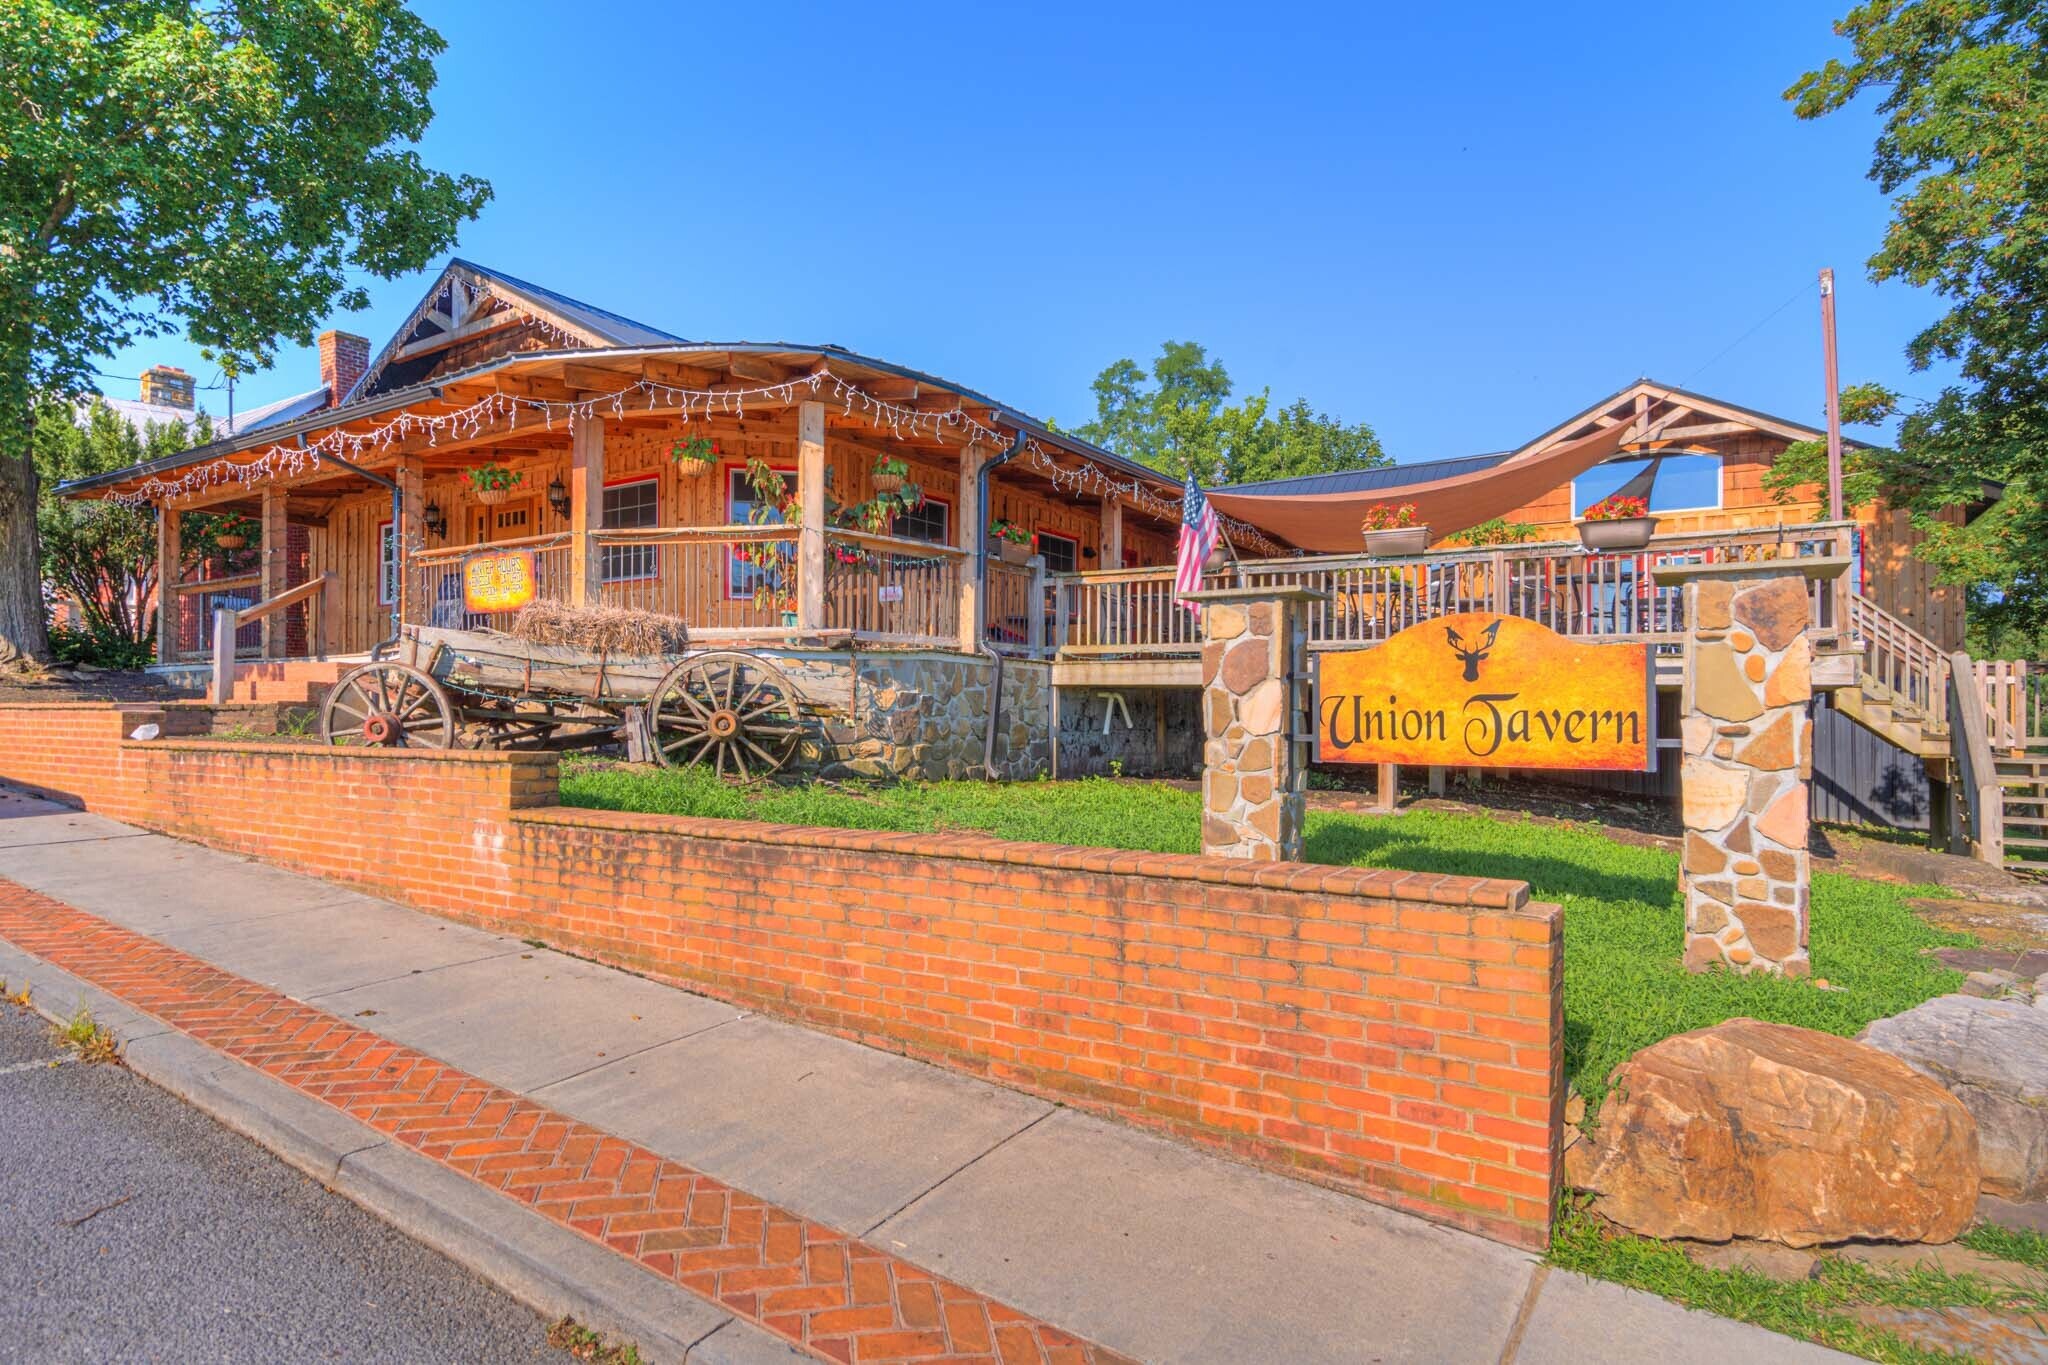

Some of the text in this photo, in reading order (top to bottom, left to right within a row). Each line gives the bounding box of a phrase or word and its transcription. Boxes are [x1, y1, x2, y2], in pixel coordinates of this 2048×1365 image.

[497, 557, 522, 573] HOURS
[1320, 692, 1641, 757] Union Tavern
